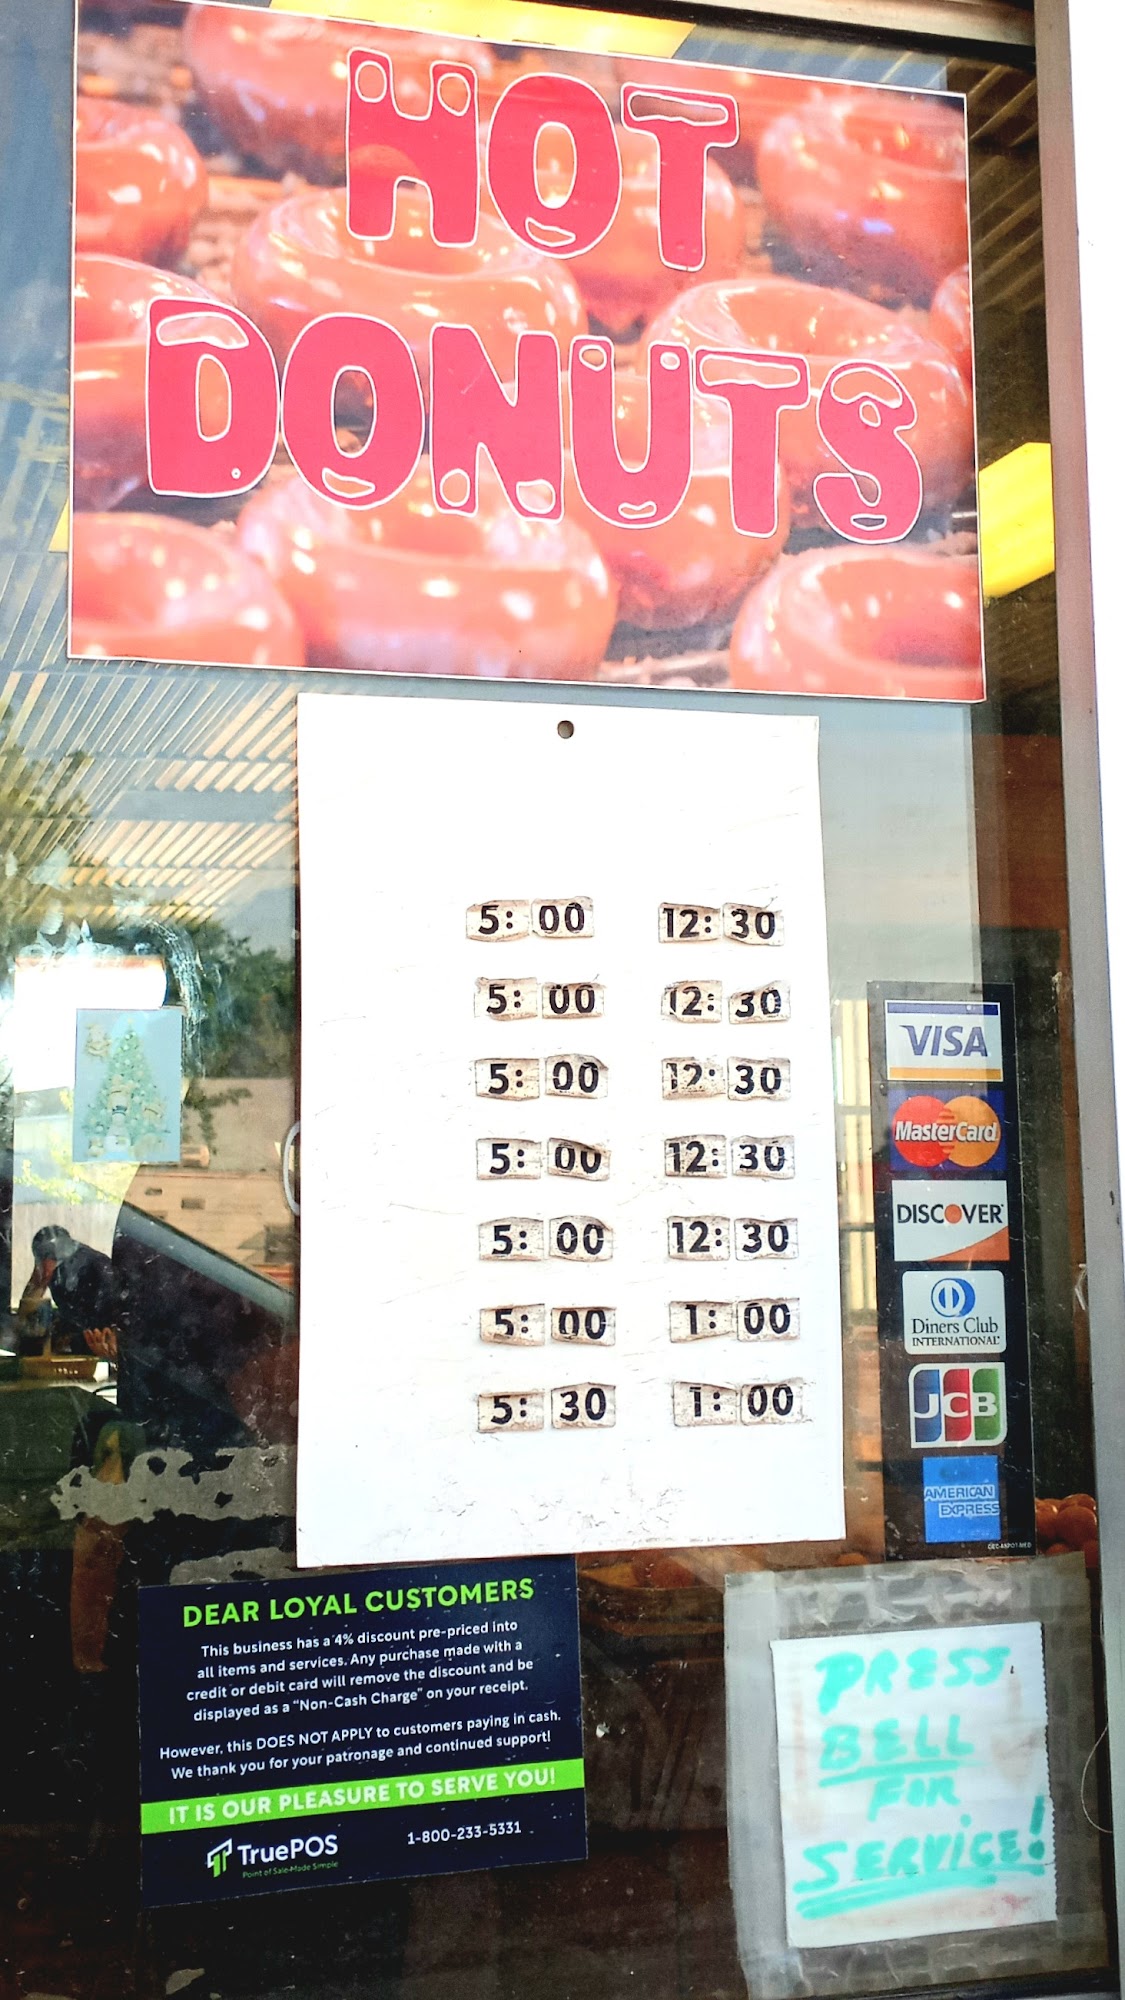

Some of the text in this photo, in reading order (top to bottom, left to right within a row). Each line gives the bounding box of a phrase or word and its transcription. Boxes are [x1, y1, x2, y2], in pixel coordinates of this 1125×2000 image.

[345, 48, 738, 271] HOT
[147, 297, 923, 545] DONUTS
[478, 902, 775, 940] 5:00 12:30
[486, 984, 596, 1015] 5:00
[899, 1025, 988, 1057] VISA
[488, 1061, 599, 1094] 5:00
[895, 1120, 998, 1143] MasterCard
[489, 1140, 786, 1174] 5:00 12:30
[897, 1203, 1003, 1224] DISCOVER
[491, 1221, 789, 1256] 5:00 12:30
[494, 1303, 791, 1341] 5:00 1:00
[911, 1316, 999, 1335] Diners Club
[912, 1336, 1000, 1347] INTERNATIONAL
[491, 1384, 794, 1425] 5:30 1:00
[913, 1391, 998, 1418] JCB
[924, 1485, 994, 1500] AMERICAN
[940, 1503, 1000, 1517] EXPRESS
[183, 1578, 534, 1628] DEAR LOYAL CUSTOMERS
[201, 1620, 518, 1658] This business has a 4% discount pre-priced into
[197, 1640, 523, 1679] all items and services. Any purchase made with a
[186, 1658, 534, 1701] credit or debit card will remove the discount and be
[815, 1647, 1011, 1715] PRESS
[193, 1703, 260, 1722] displayed
[263, 1703, 279, 1715] as
[282, 1703, 290, 1713] a
[426, 1688, 443, 1700] on
[446, 1685, 476, 1700] your
[479, 1680, 529, 1695] receipt.
[227, 1739, 253, 1753] this
[256, 1734, 295, 1750] DOES
[298, 1731, 329, 1746] NOT
[331, 1726, 374, 1743] APPLY
[376, 1726, 390, 1738] to
[393, 1719, 463, 1737] customers
[466, 1714, 510, 1732] paying
[513, 1712, 526, 1724] in
[528, 1709, 561, 1724] cash.
[819, 1714, 975, 1769] BELL
[171, 1730, 551, 1780] We thank you for your patronage and continued support!
[169, 1767, 555, 1825] IT IS OUR PLEASURE TO SERVE YOU!
[867, 1776, 959, 1821] FOR
[237, 1834, 338, 1866] TruePOS
[407, 1821, 522, 1845] 1-800-233-5331
[243, 1869, 263, 1878] Point
[312, 1861, 339, 1870] Simple
